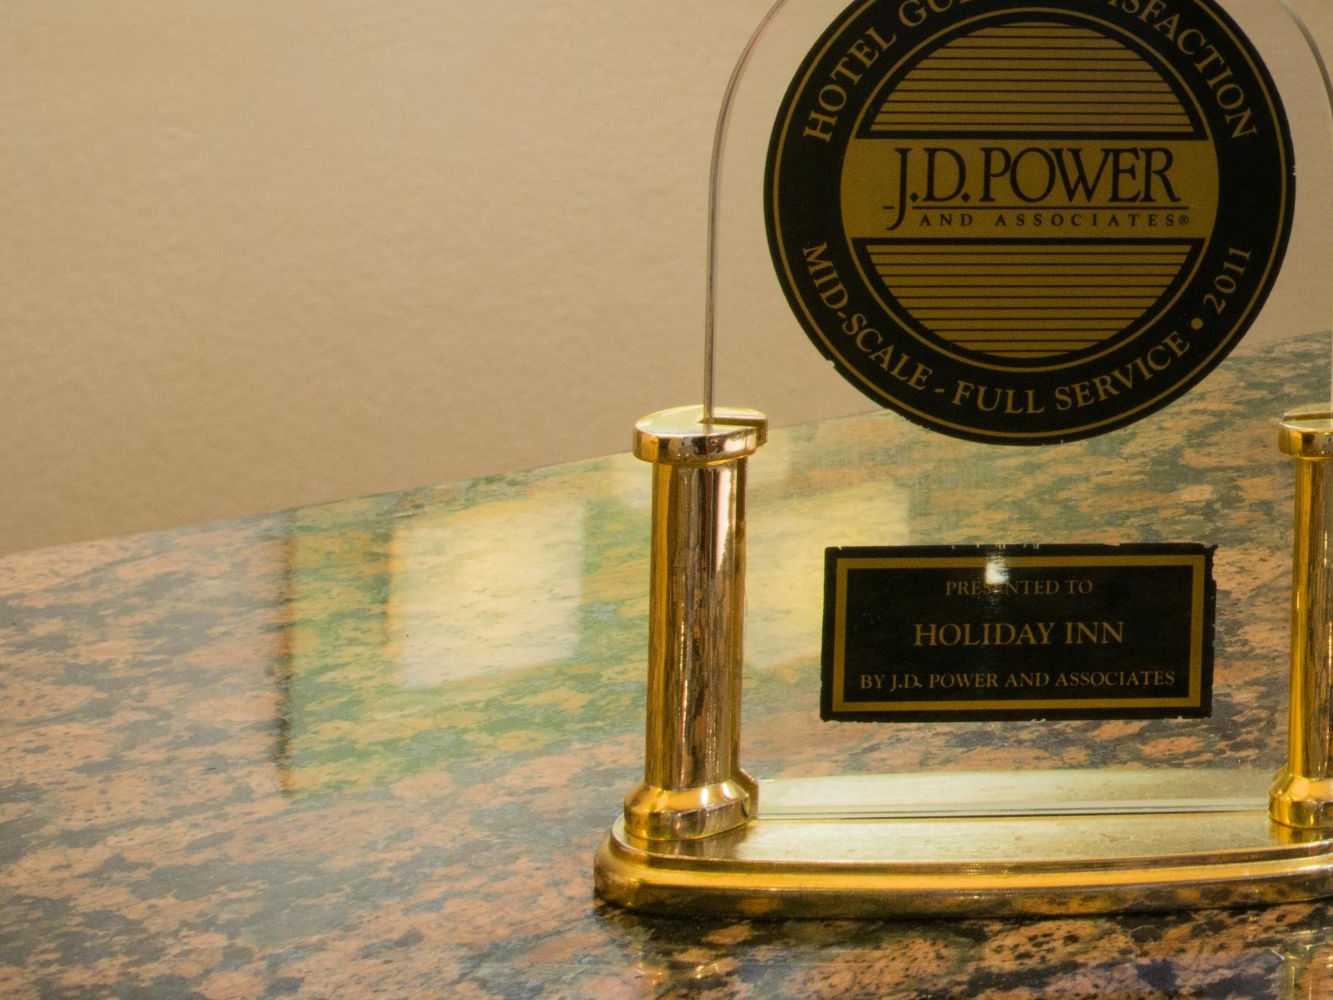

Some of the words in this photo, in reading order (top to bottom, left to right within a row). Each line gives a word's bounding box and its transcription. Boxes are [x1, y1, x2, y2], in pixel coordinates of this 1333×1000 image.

[803, 26, 897, 143] HOTEL
[979, 146, 1182, 203] POWER
[919, 212, 973, 228] AND
[803, 241, 932, 391] MID-SCALE
[952, 380, 1045, 415] FULL
[1056, 330, 1190, 412] SERVICE
[1203, 247, 1251, 316] 2011
[1066, 579, 1093, 594] TO
[914, 621, 1055, 647] HOLIDAY
[1065, 620, 1125, 644] INN
[860, 674, 885, 689] BY
[929, 672, 998, 688] POWER
[1004, 671, 1049, 687] AND
[1056, 670, 1175, 687] ASSOCIATES
